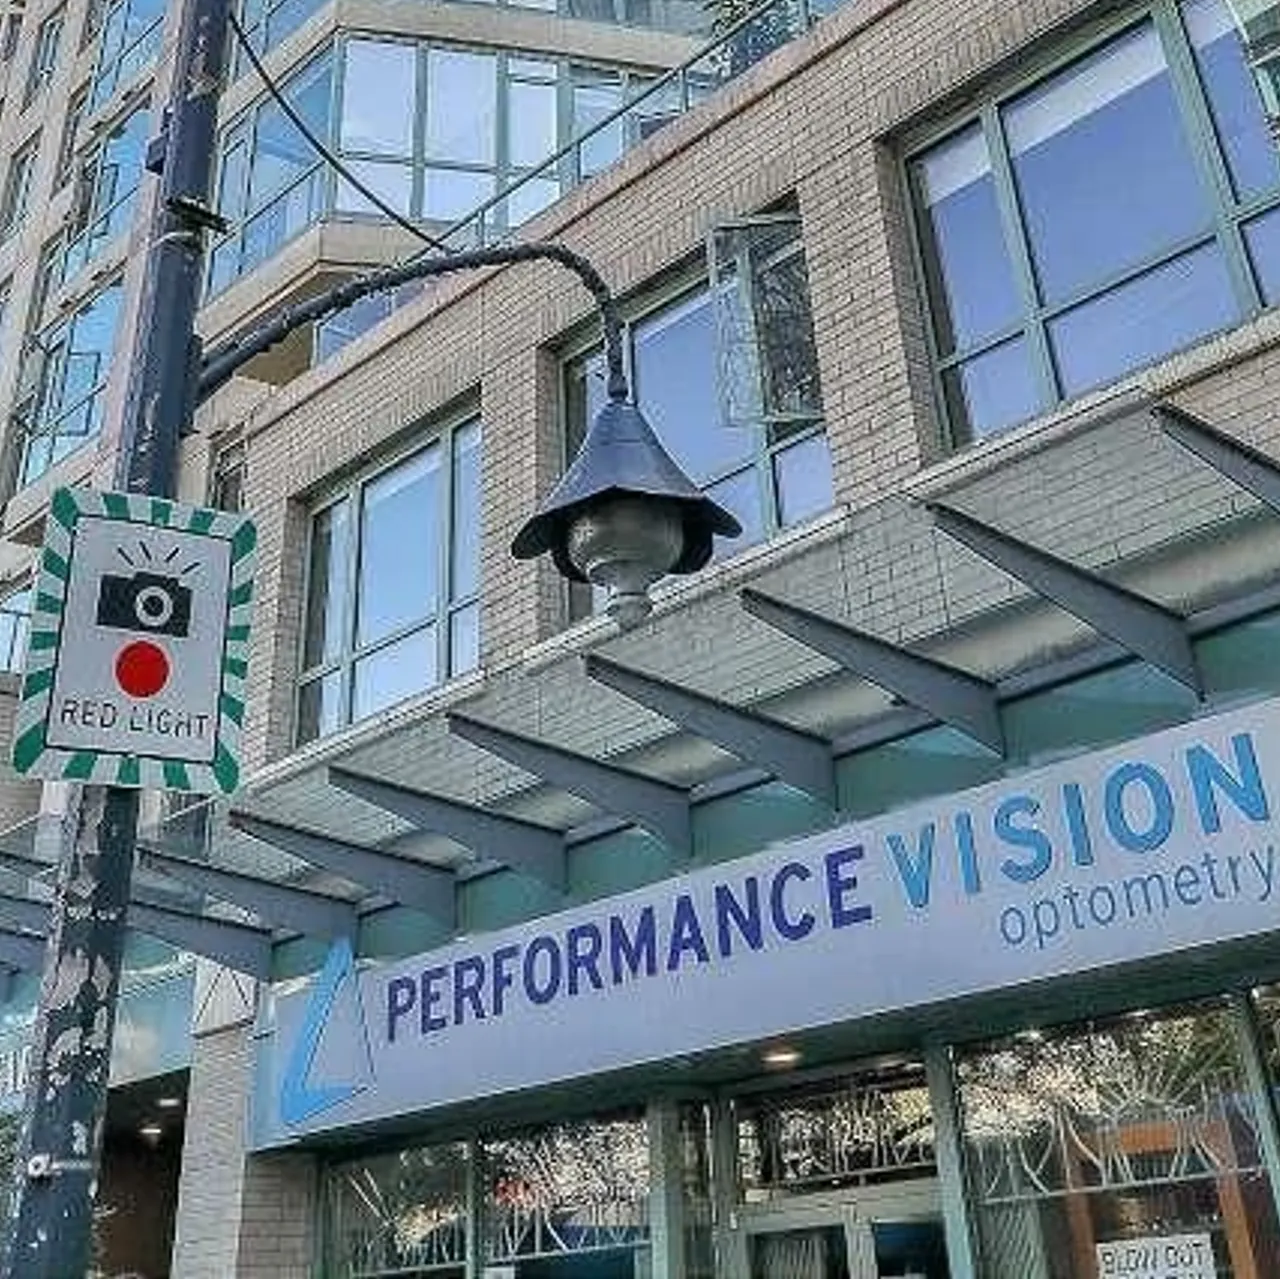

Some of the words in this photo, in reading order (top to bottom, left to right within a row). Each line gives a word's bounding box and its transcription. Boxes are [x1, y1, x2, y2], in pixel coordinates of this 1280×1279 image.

[60, 698, 118, 729] RED
[129, 705, 209, 738] LIGHT
[386, 845, 873, 1042] PERFORMANCE
[886, 732, 1271, 909] VISION
[999, 845, 1276, 950] optometry
